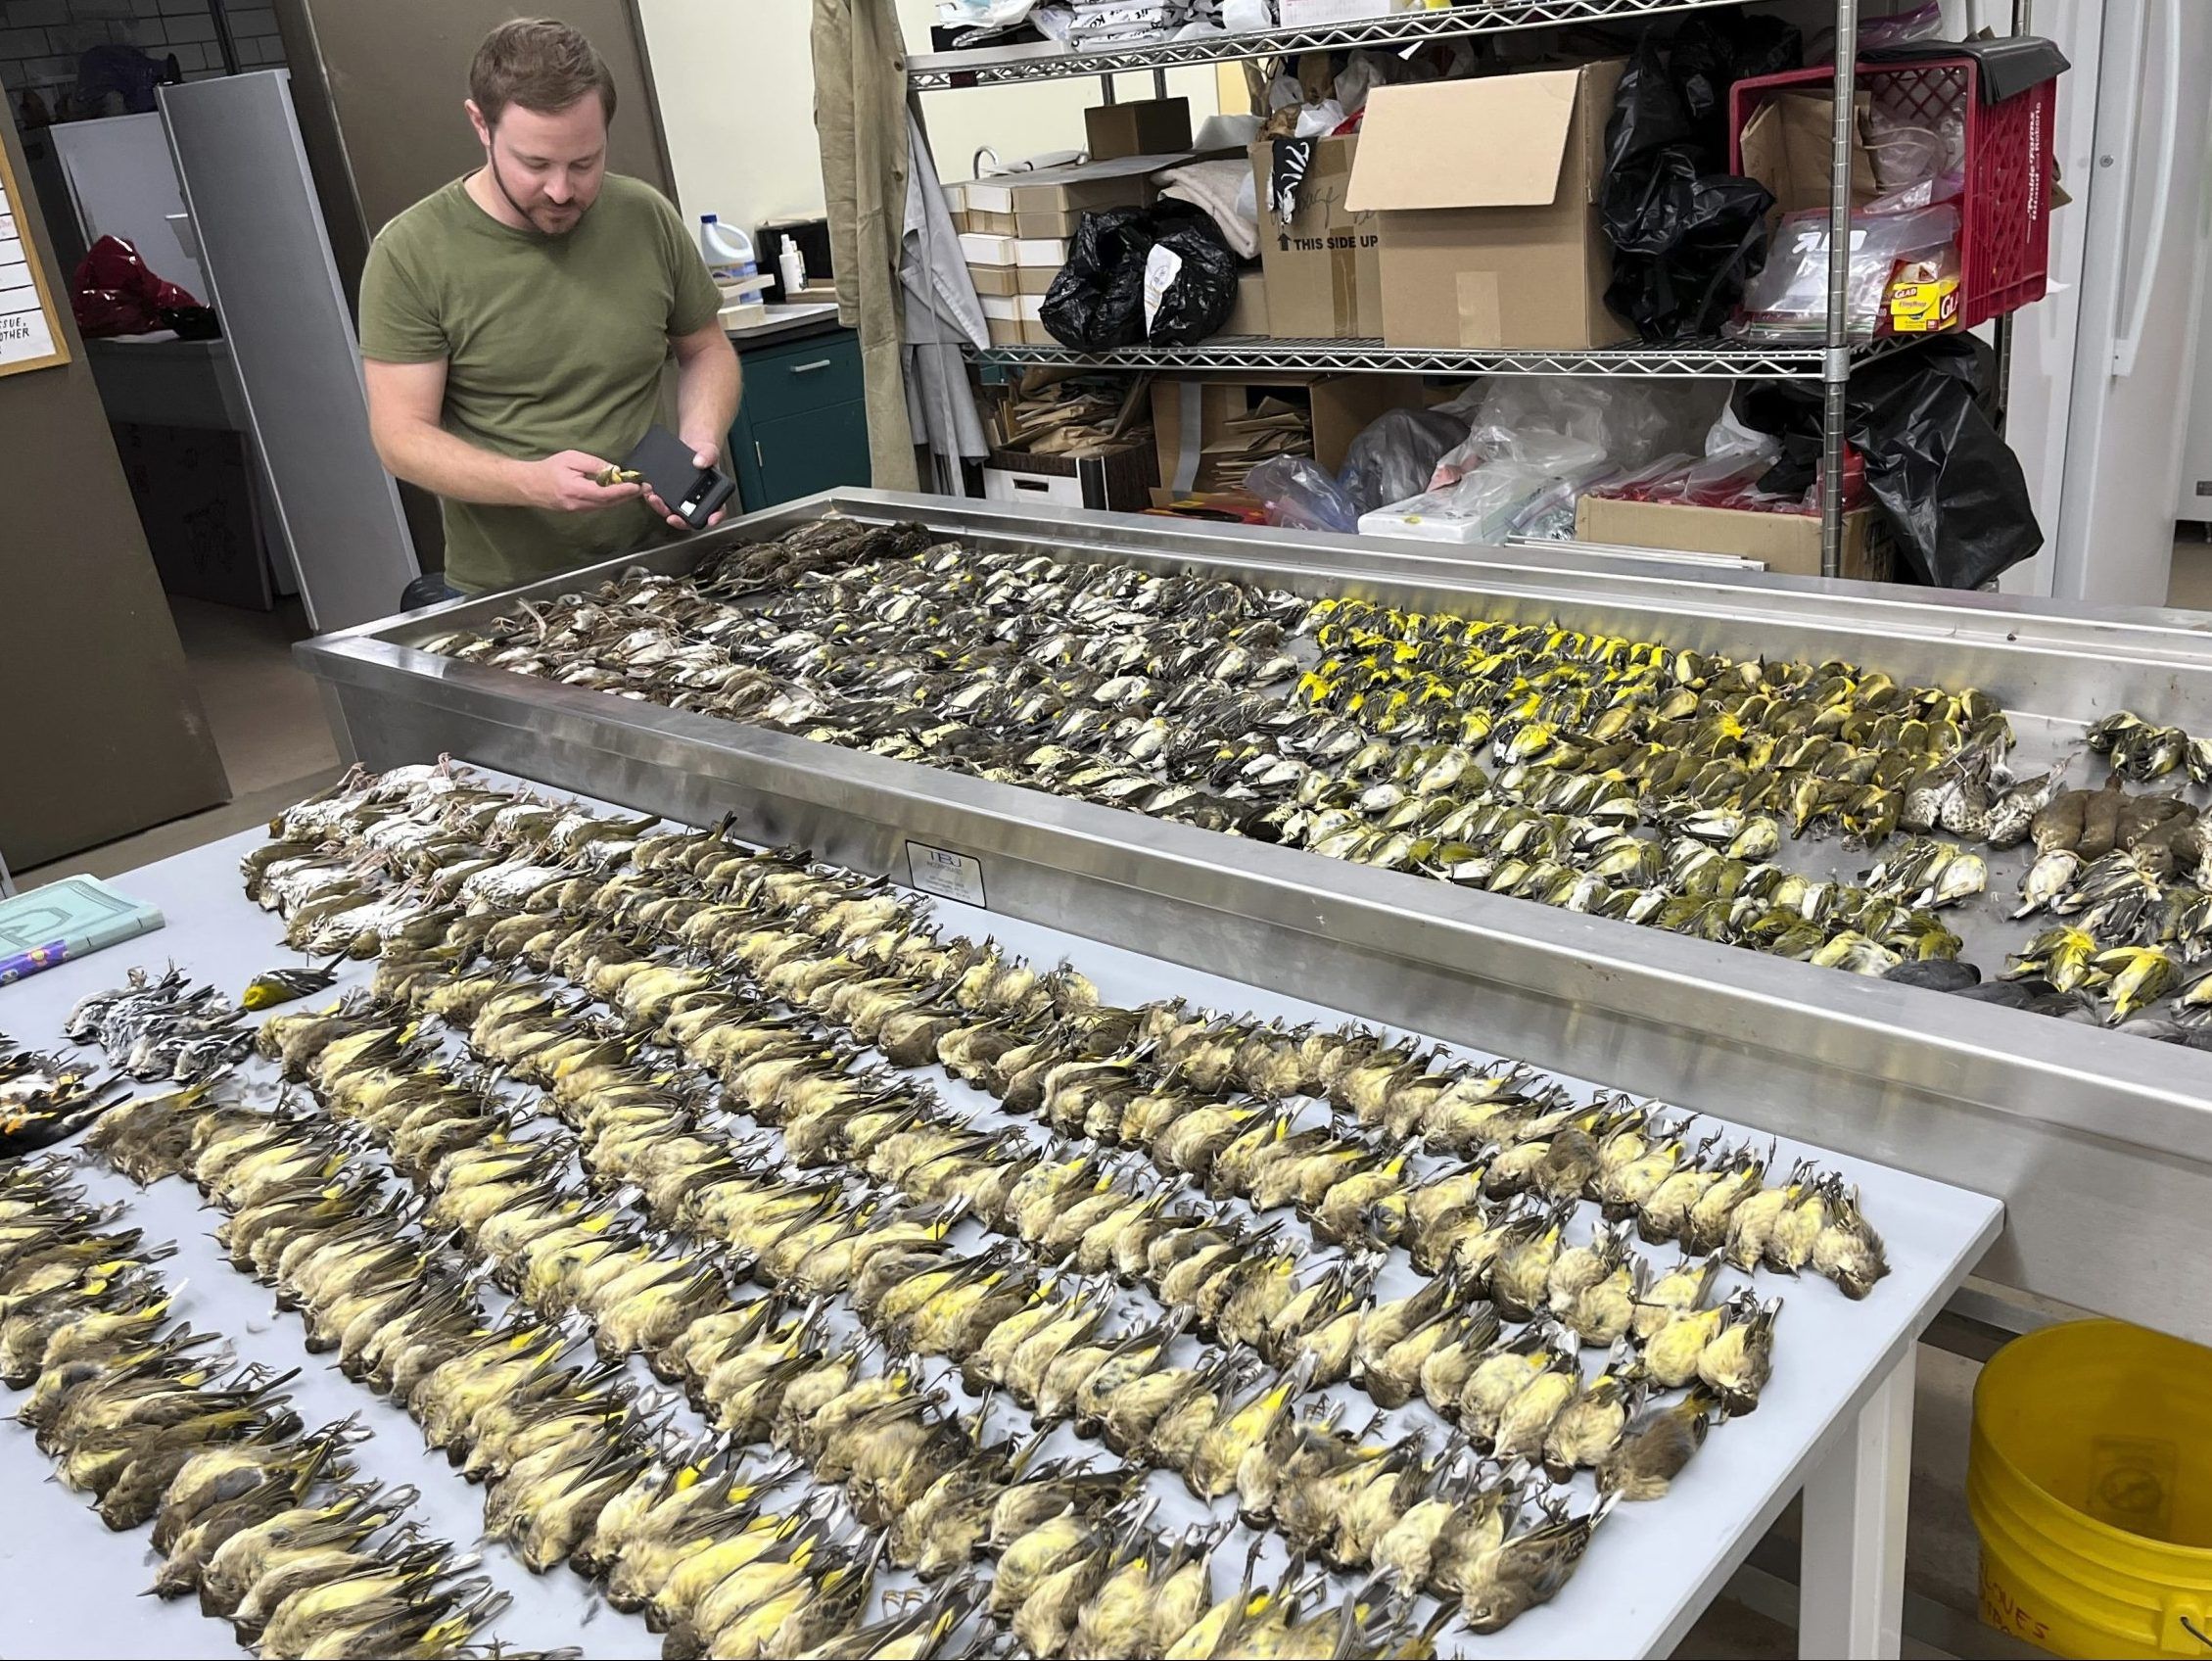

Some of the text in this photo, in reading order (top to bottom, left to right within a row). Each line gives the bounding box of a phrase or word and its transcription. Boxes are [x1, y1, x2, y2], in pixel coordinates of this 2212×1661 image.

[1294, 235, 1379, 251] THIS SIDE UP
[1895, 288, 1917, 299] GLAD
